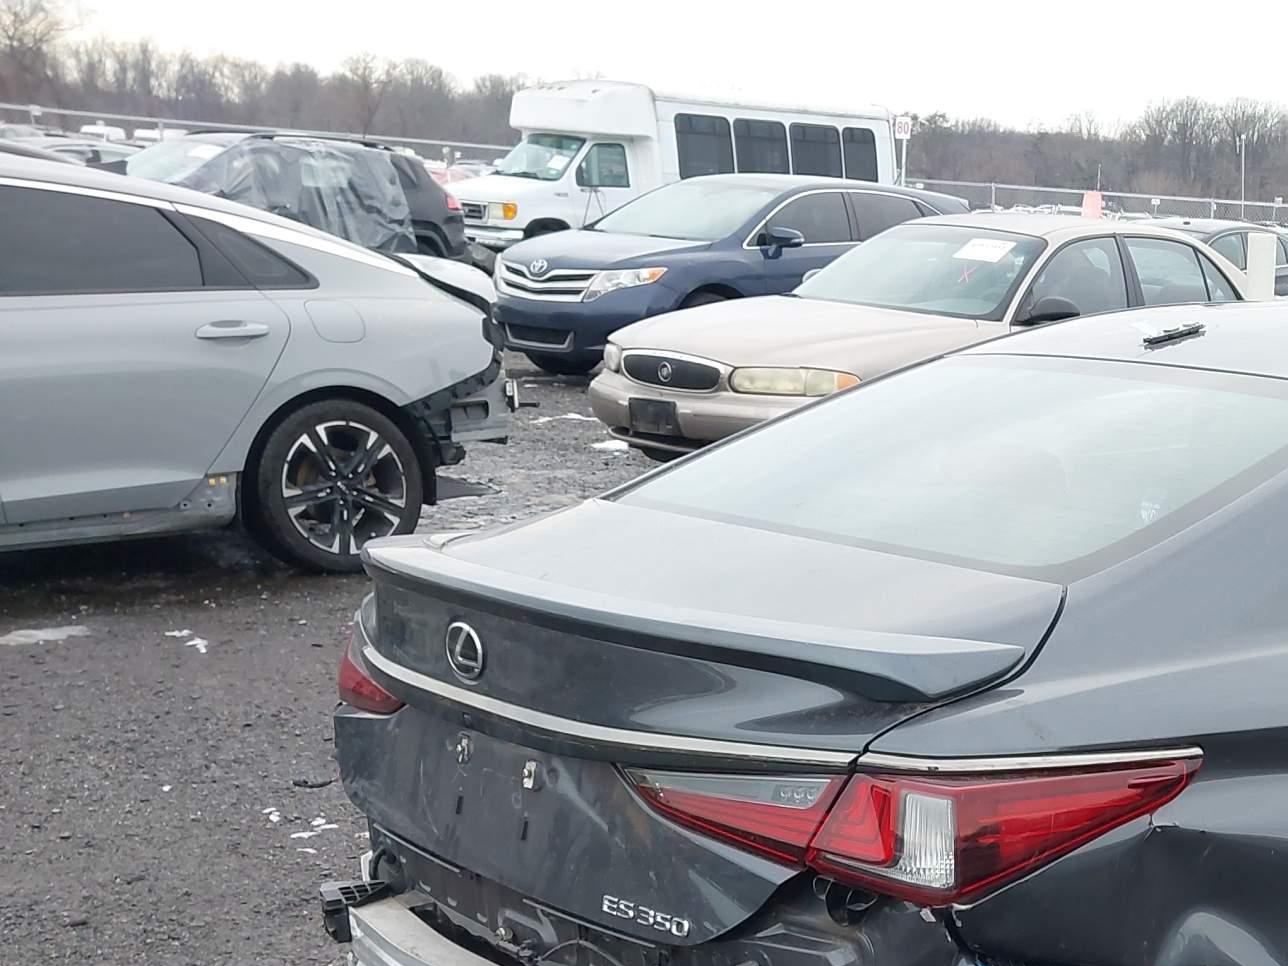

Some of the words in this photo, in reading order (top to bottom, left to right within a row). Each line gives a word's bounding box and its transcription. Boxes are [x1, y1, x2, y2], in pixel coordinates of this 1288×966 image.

[897, 121, 909, 135] 80
[602, 895, 634, 918] ES
[636, 906, 690, 937] 350
